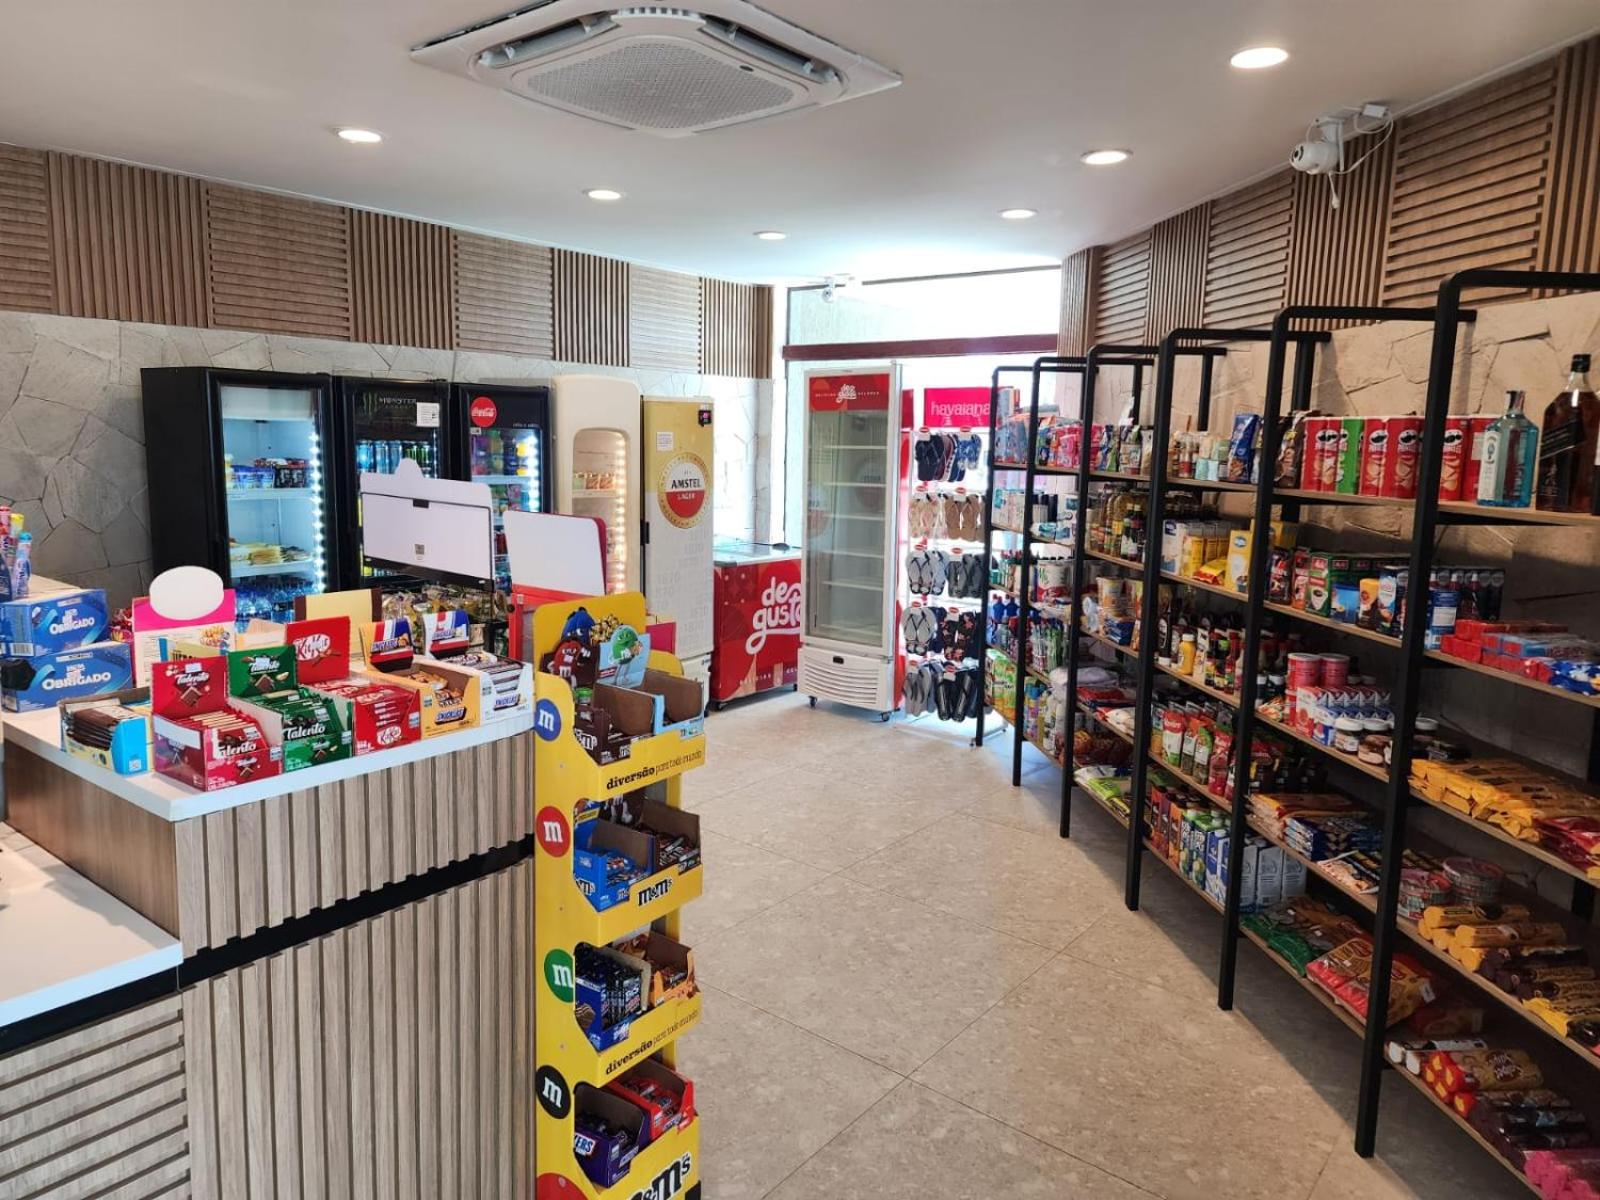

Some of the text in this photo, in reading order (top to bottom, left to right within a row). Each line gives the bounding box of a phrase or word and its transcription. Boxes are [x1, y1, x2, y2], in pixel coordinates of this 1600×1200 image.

[931, 401, 991, 417] havaiana
[671, 479, 701, 489] AMSTEL
[762, 576, 797, 607] de
[42, 672, 111, 690] OBRIGADO
[281, 722, 326, 740] Talento
[606, 766, 655, 790] diversão
[606, 1040, 653, 1075] diversão
